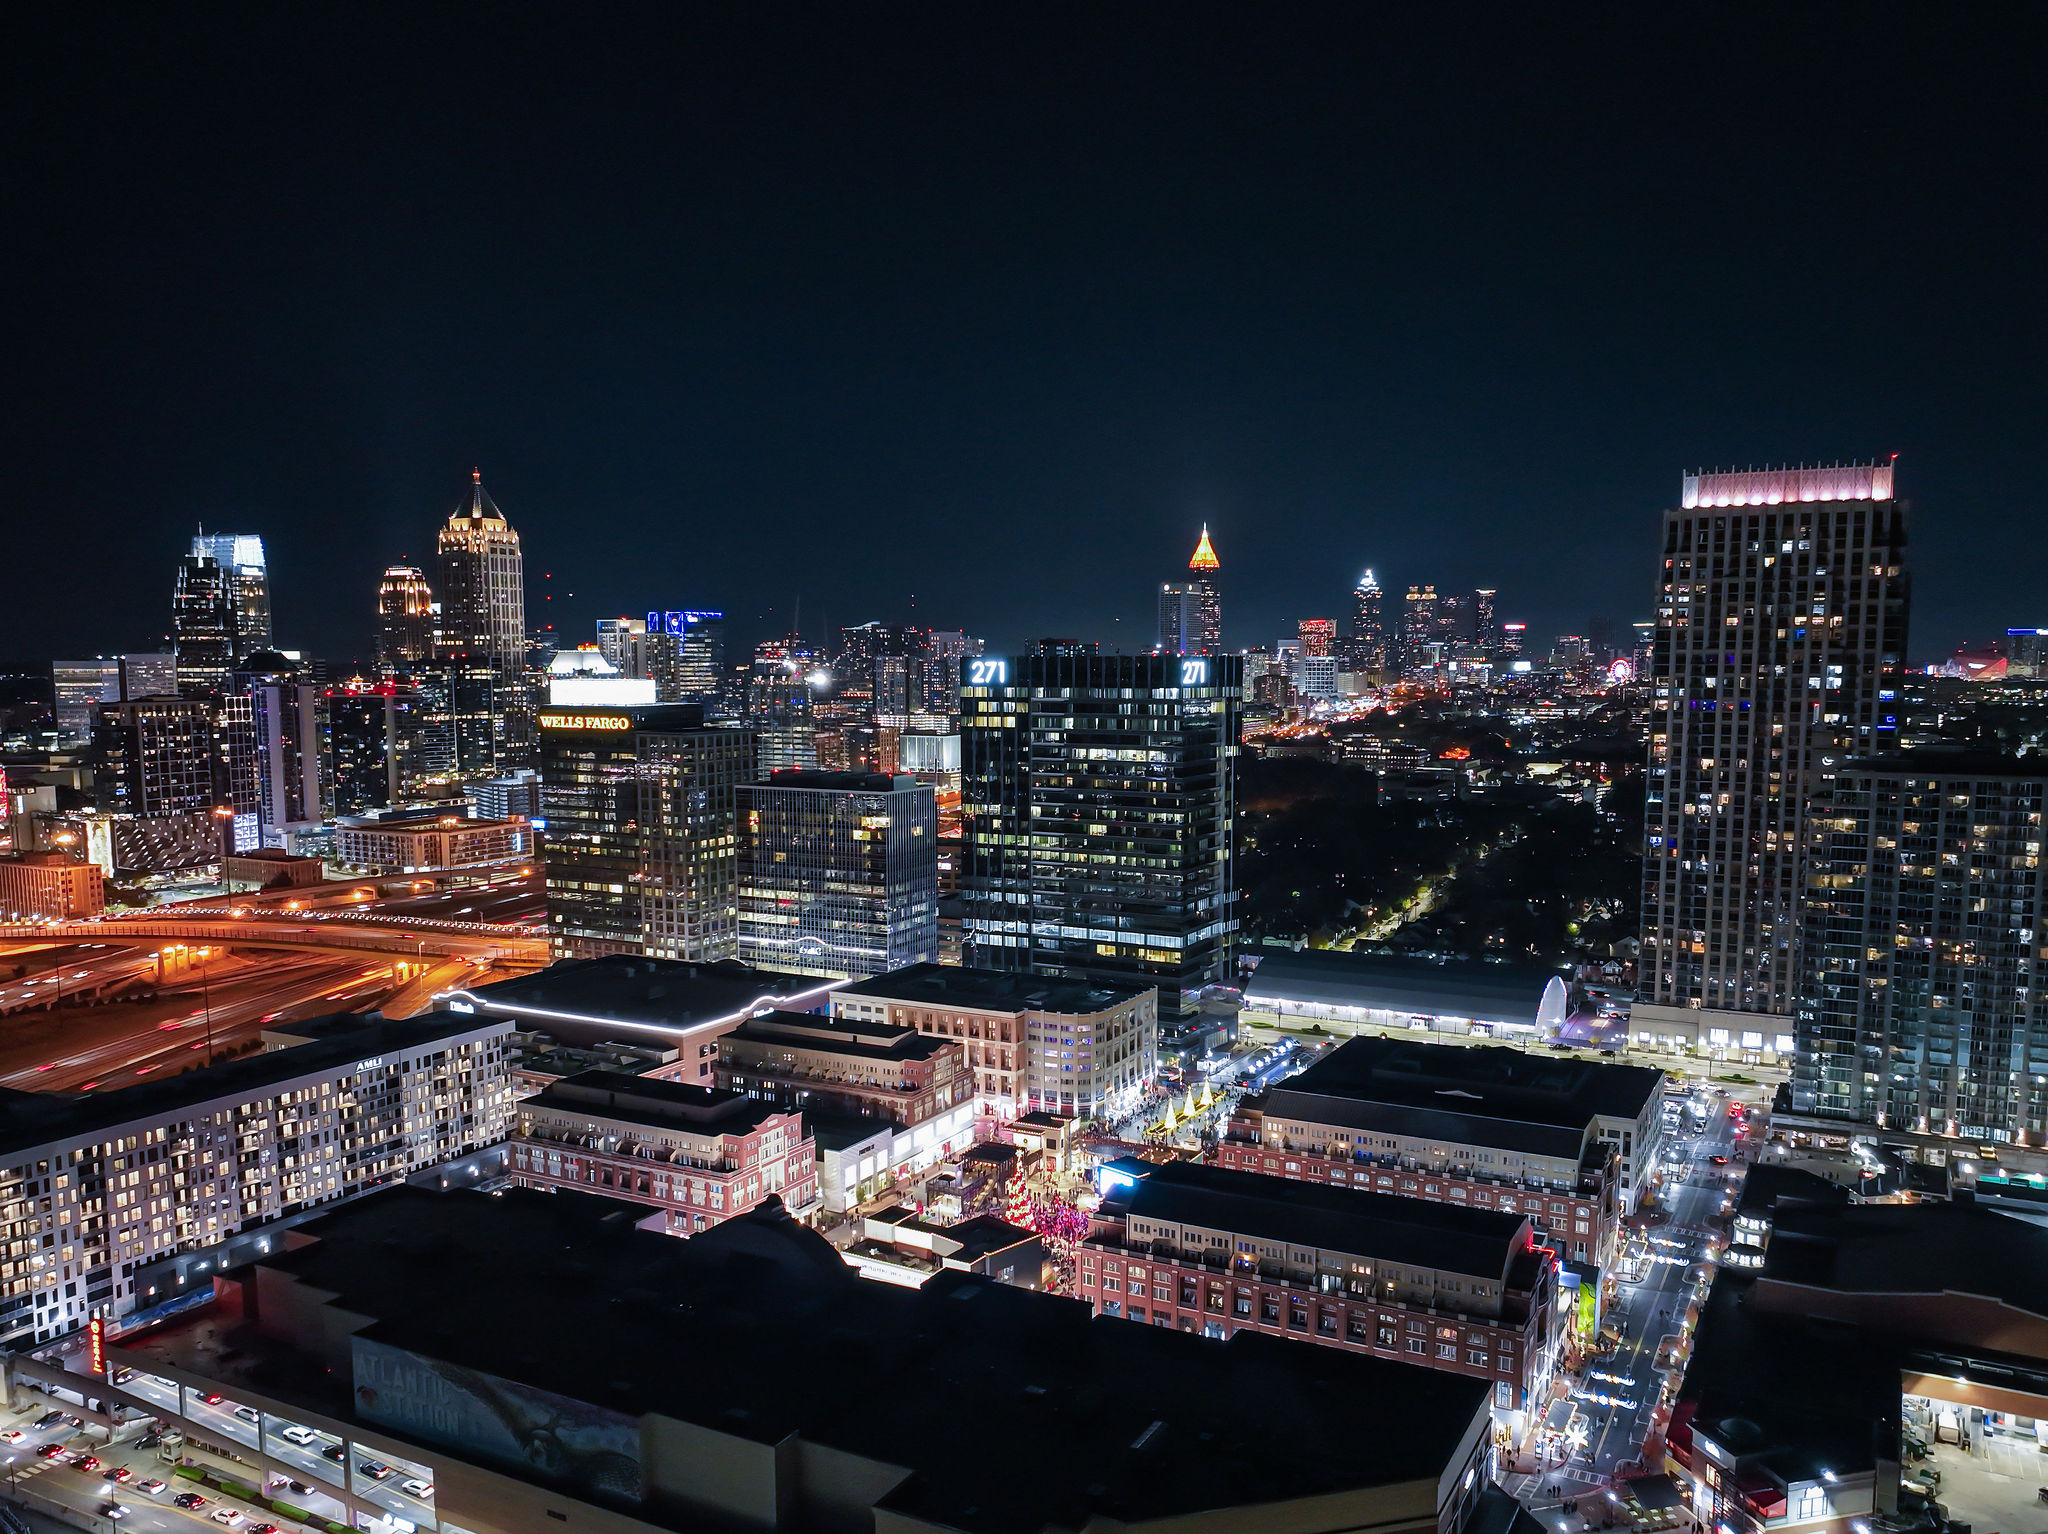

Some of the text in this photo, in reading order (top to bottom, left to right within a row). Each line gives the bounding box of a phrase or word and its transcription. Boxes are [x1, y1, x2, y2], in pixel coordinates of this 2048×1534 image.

[971, 661, 1005, 684] 271
[1182, 661, 1205, 684] 271
[540, 715, 629, 731] WELLS FARGO
[356, 1057, 382, 1072] AMLI
[92, 1334, 101, 1368] REGAL
[357, 1351, 450, 1404] ATLANTIC
[382, 1391, 460, 1435] STATION
